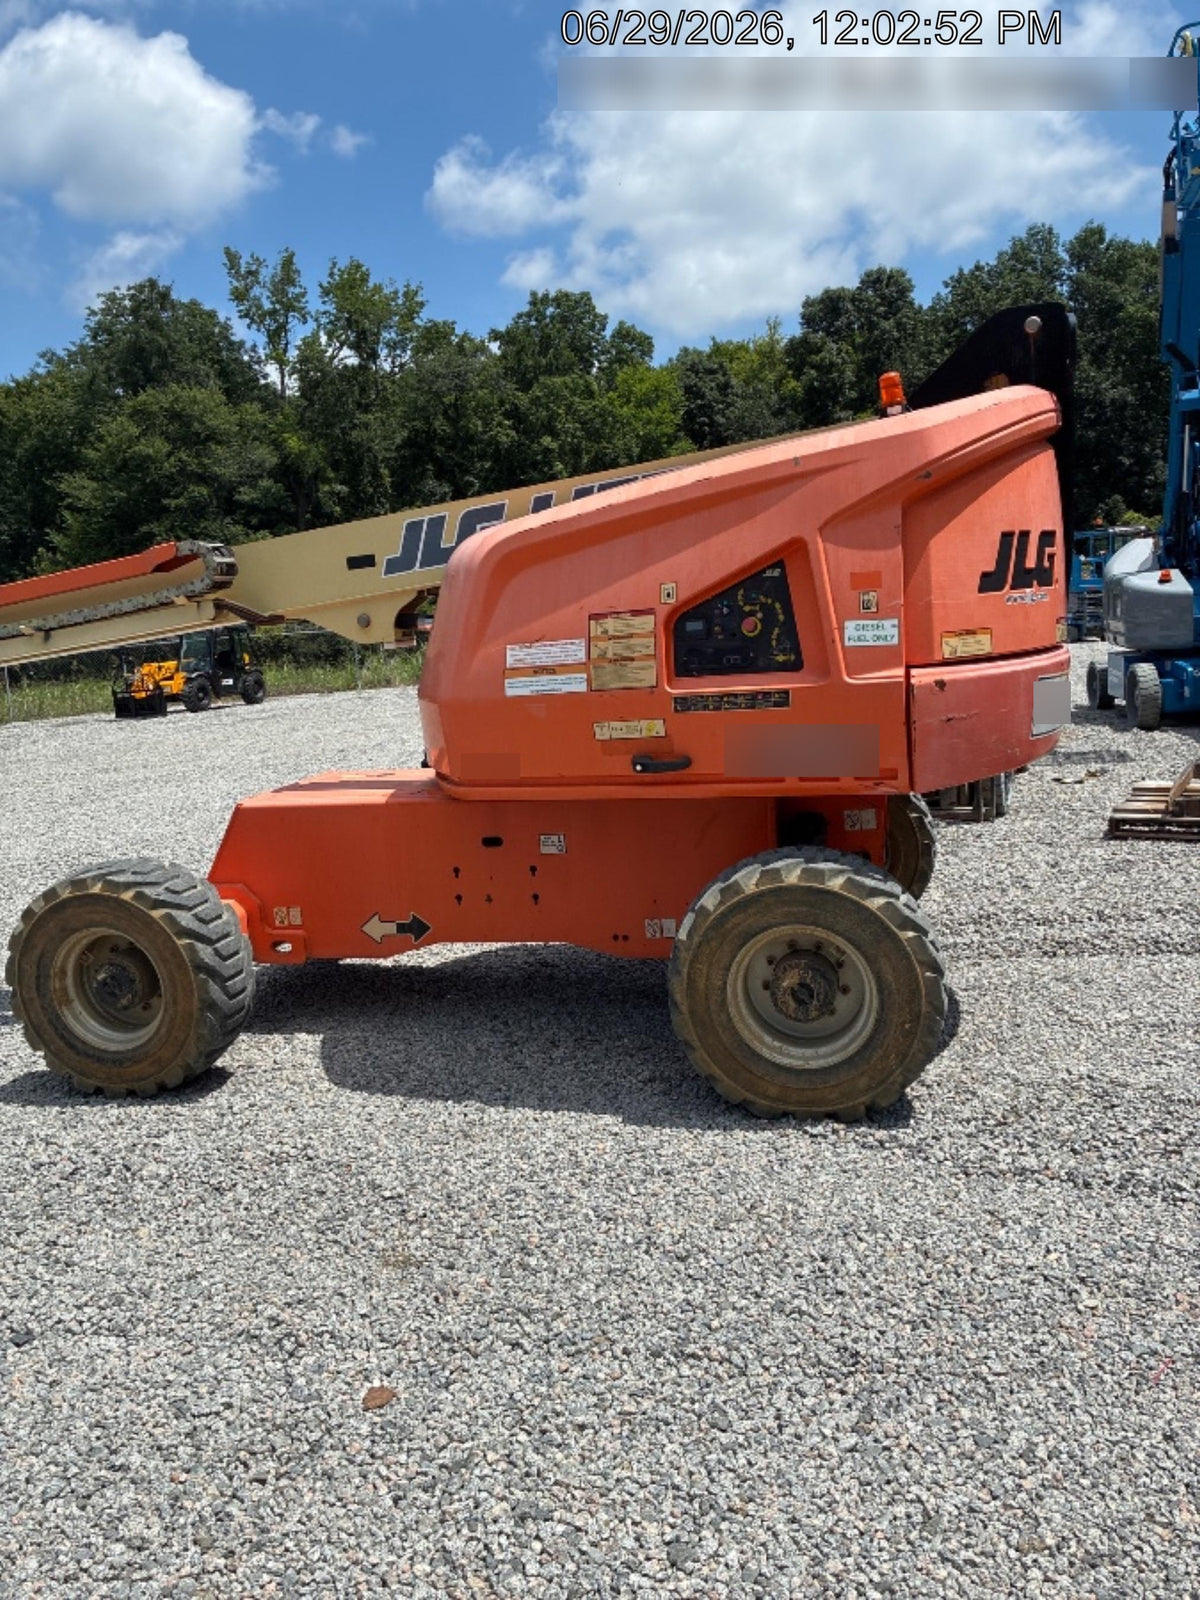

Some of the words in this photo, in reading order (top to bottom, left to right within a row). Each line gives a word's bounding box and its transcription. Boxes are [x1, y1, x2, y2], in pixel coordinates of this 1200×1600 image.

[978, 529, 1057, 594] JLG
[854, 623, 886, 632] DIESEL
[847, 634, 870, 643] FUEL
[871, 633, 896, 643] ONLY
